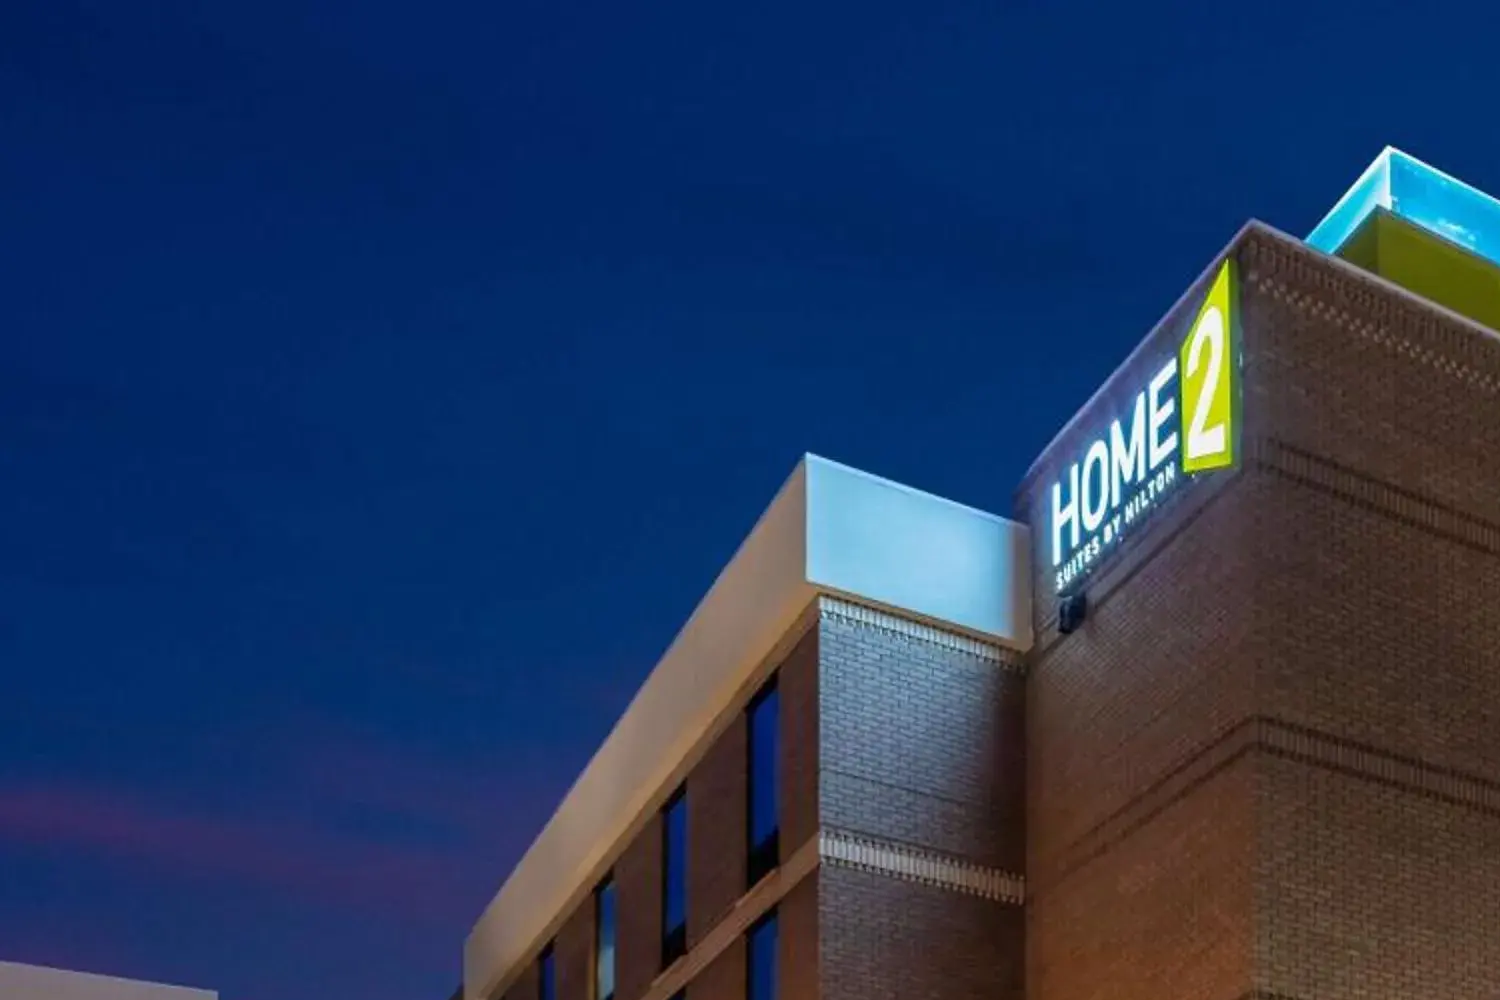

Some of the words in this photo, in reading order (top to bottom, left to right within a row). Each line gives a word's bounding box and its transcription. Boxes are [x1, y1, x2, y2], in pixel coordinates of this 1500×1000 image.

[1052, 355, 1178, 567] HOME
[1186, 305, 1225, 459] 2
[1055, 536, 1100, 590] SUITES
[1100, 517, 1121, 545] BY
[1125, 461, 1176, 524] HILTON
